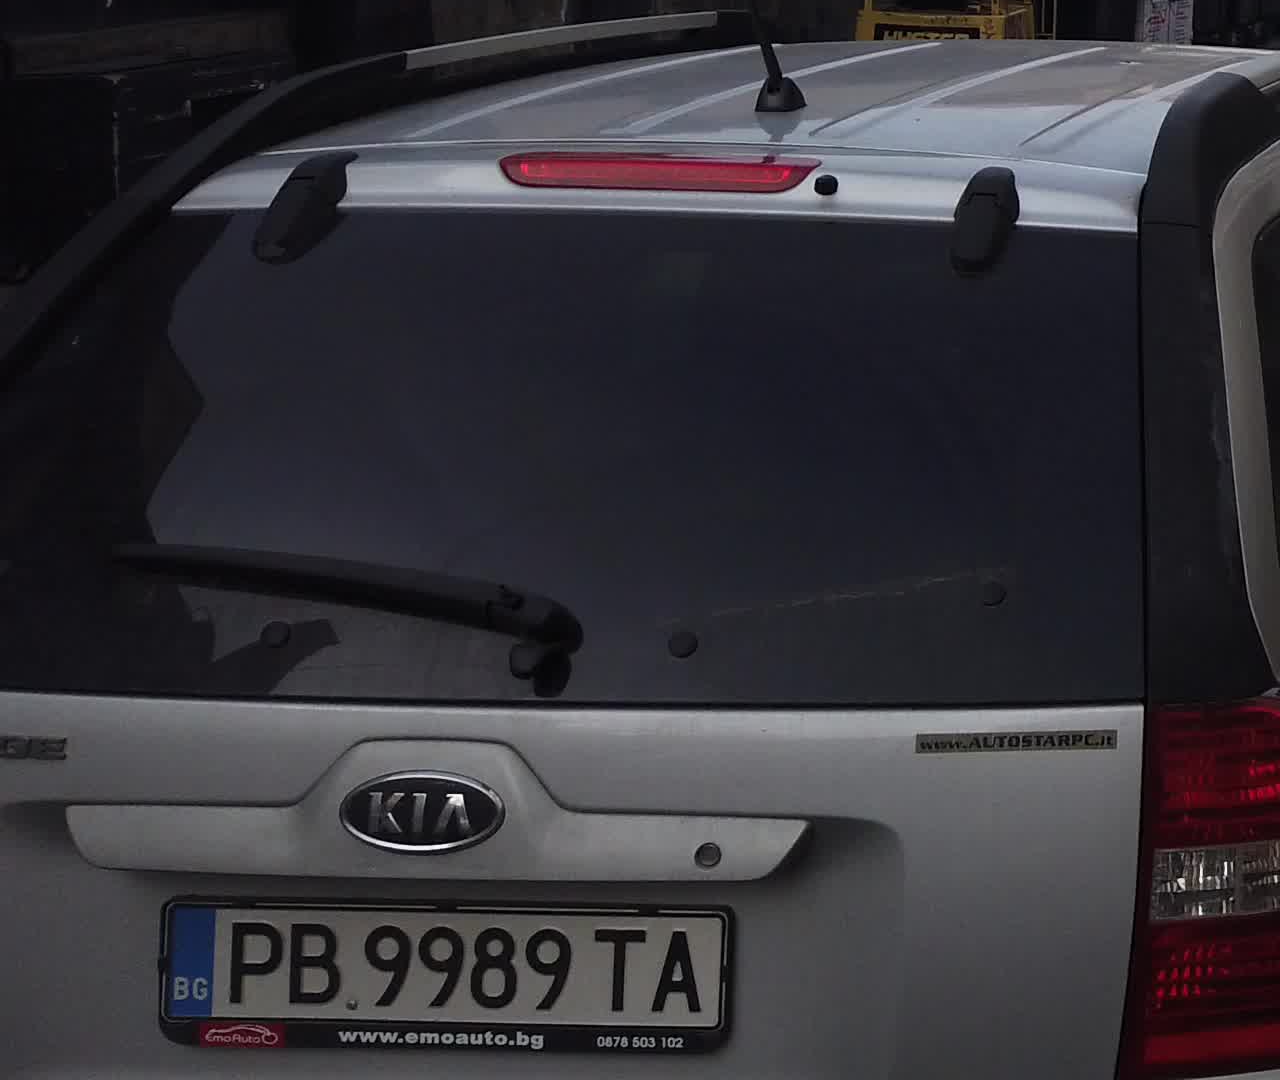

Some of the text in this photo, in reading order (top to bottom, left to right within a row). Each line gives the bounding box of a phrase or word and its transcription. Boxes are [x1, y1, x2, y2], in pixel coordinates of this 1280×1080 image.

[367, 790, 475, 834] KIA
[363, 924, 572, 1011] 9989
[595, 929, 702, 1014] TA
[173, 976, 208, 1001] BG
[338, 1030, 545, 1050] www.emoauto.bg
[596, 1035, 684, 1049] 0878 503 102
